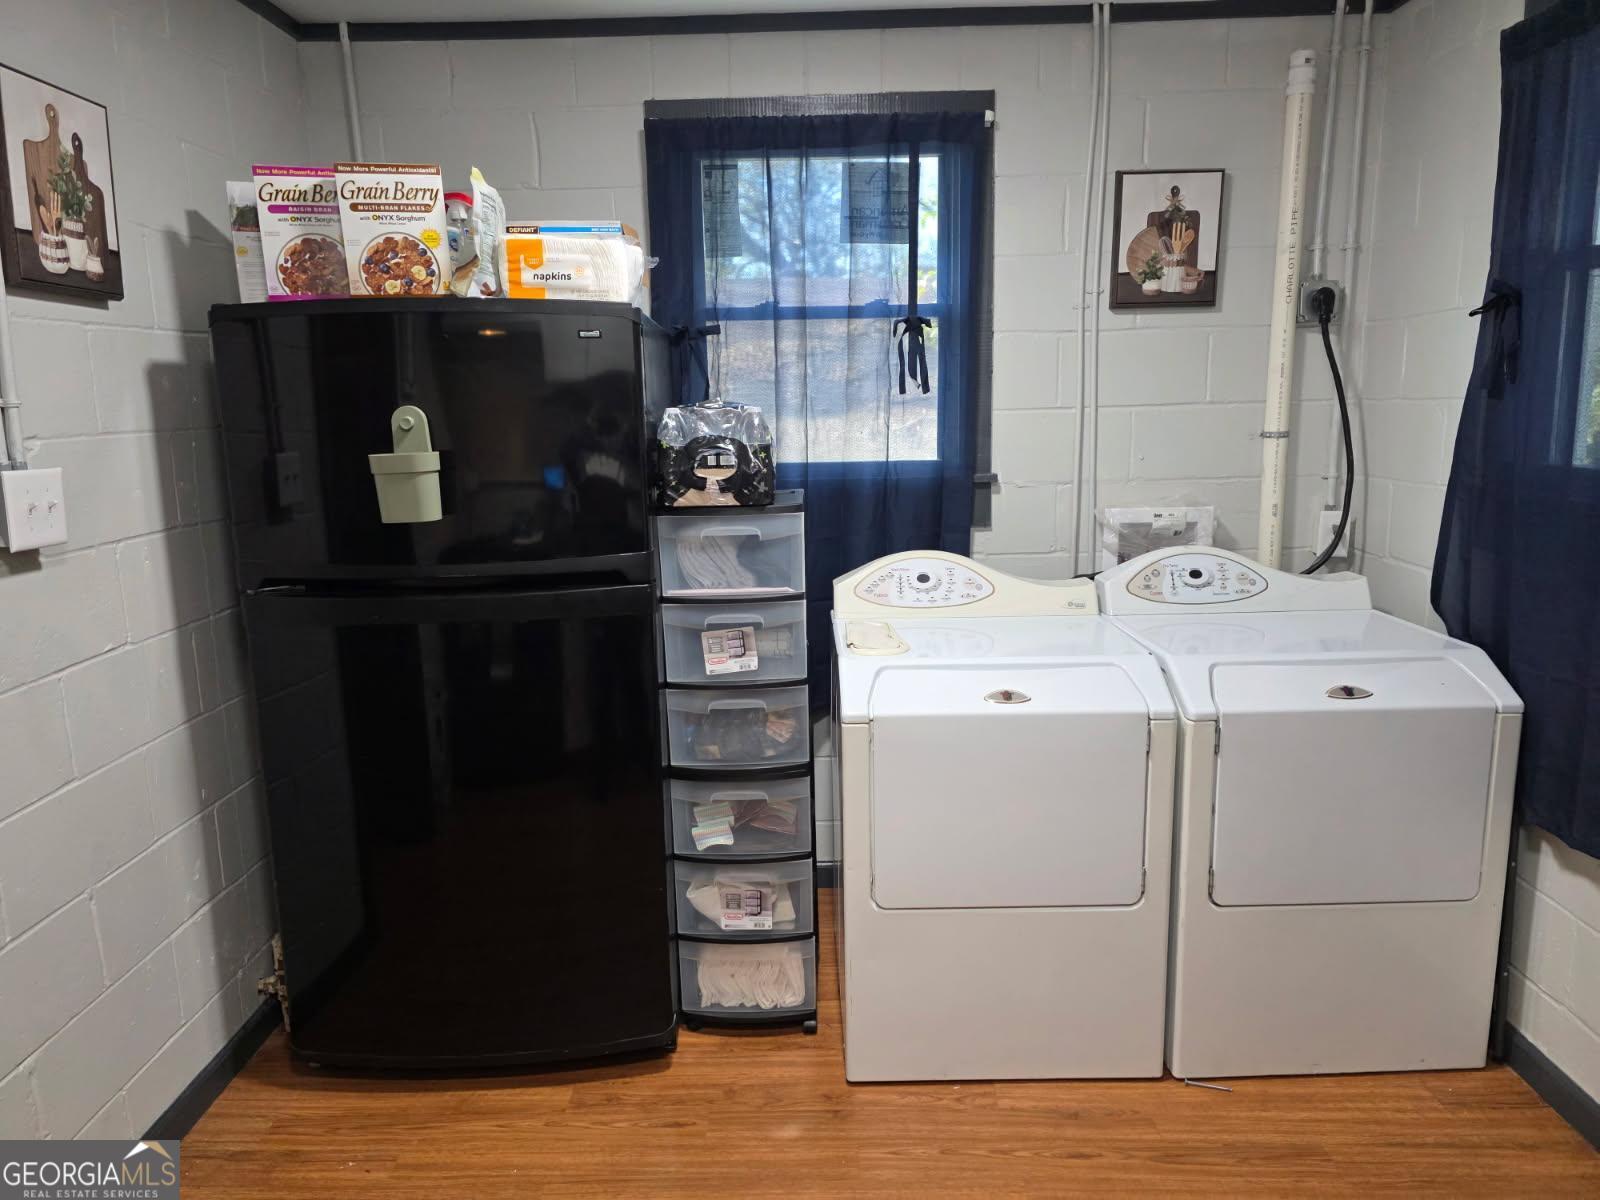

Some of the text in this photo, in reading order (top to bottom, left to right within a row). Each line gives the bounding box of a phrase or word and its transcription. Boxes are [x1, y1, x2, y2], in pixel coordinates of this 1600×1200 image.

[258, 182, 308, 203] Grain
[340, 180, 440, 209] Grain Berry
[395, 214, 426, 222] Sorghum
[1290, 207, 1299, 235] PIPE
[533, 271, 572, 282] napkins
[1285, 241, 1297, 304] CHARLOTTE
